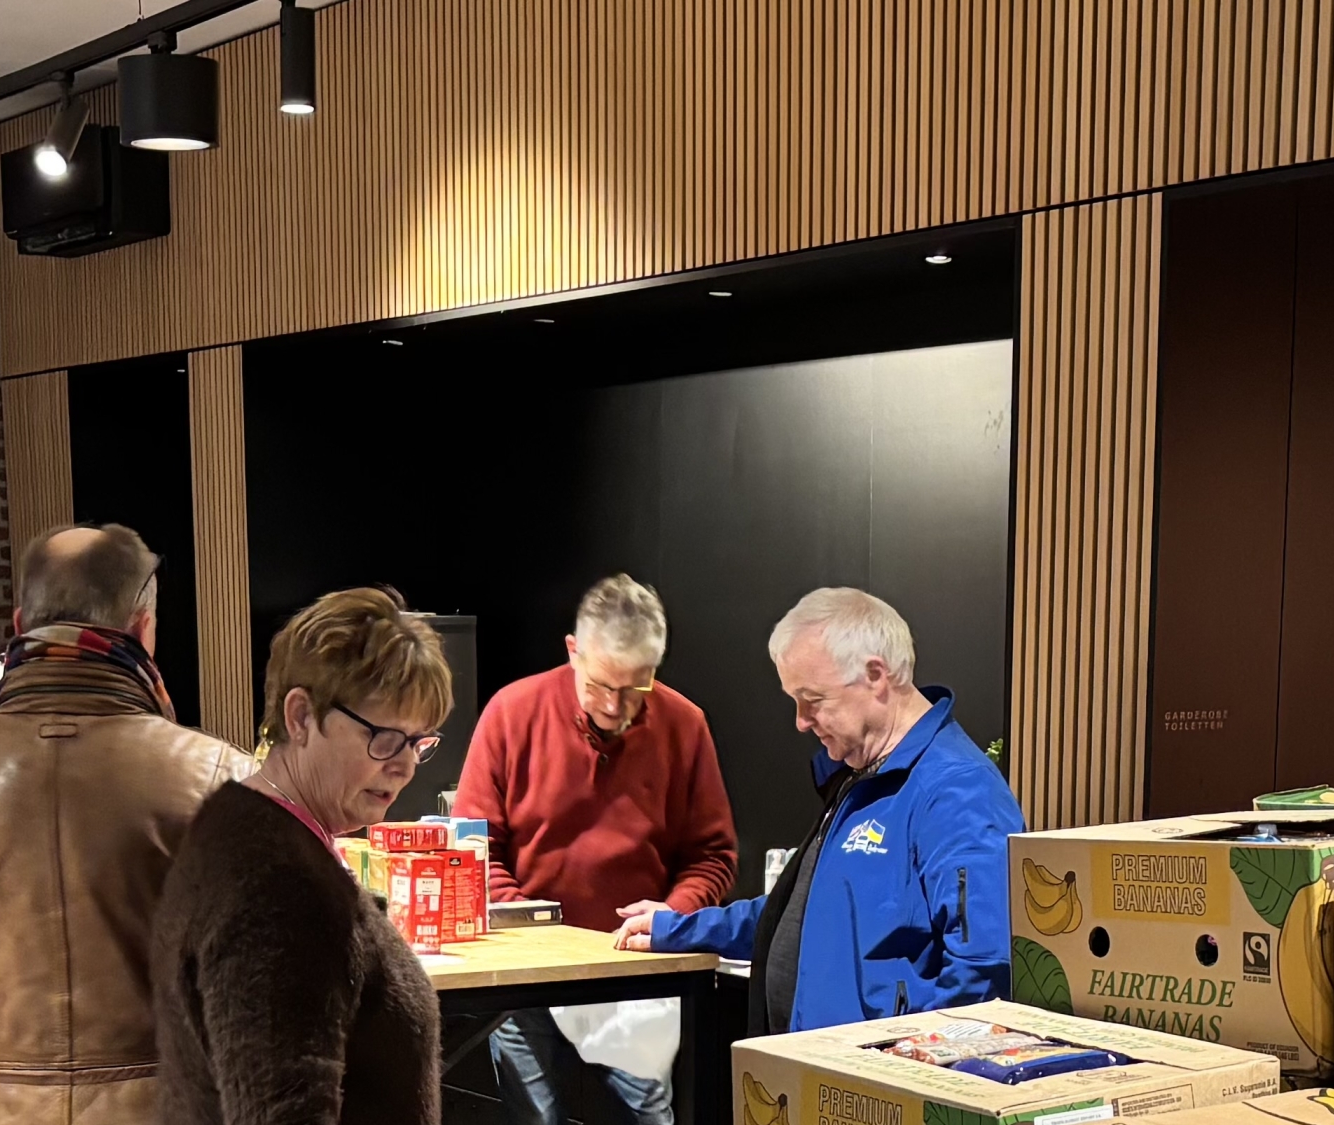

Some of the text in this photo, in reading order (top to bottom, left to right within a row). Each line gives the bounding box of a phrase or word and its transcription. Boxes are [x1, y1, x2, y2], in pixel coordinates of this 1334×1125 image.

[1164, 709, 1228, 720] GARDEROBE
[1164, 721, 1224, 731] TOILETTEN
[1112, 854, 1207, 884] PREMIUM
[1113, 884, 1206, 916] BANANAS
[1087, 969, 1236, 1008] FAIRTRADE
[1103, 1005, 1222, 1042] BANANAS
